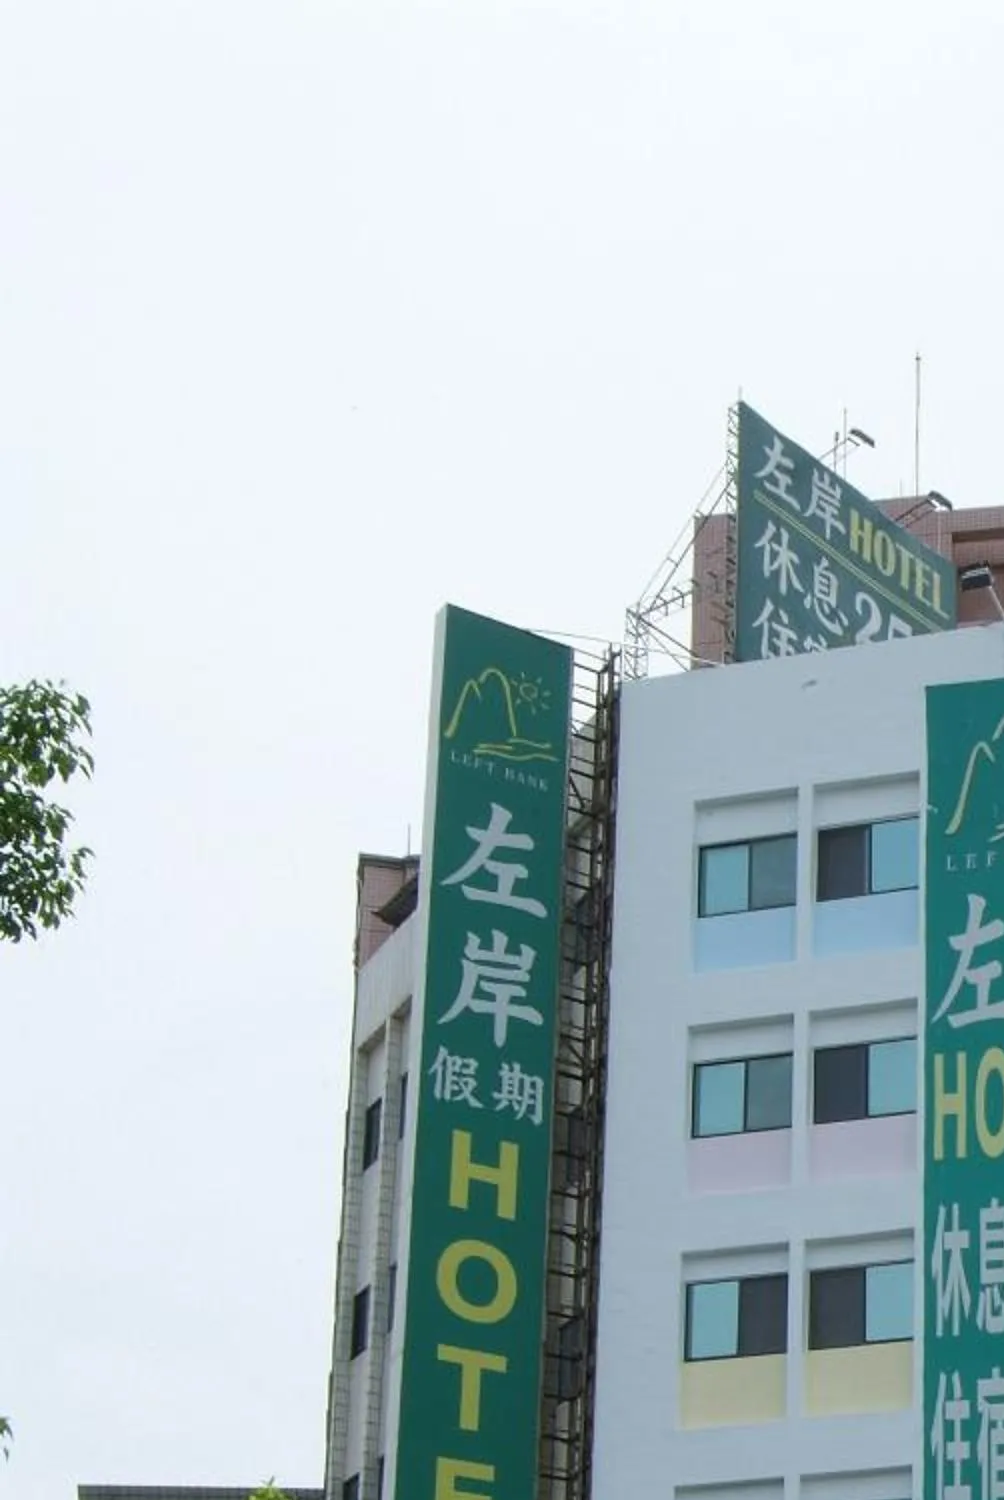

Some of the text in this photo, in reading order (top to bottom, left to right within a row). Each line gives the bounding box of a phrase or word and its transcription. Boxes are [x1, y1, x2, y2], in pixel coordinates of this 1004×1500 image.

[754, 436, 950, 620] 左岸 HOTEL
[449, 750, 549, 793] LEFT BANK
[438, 802, 548, 1048] 左岸
[428, 1045, 543, 1127] 假期
